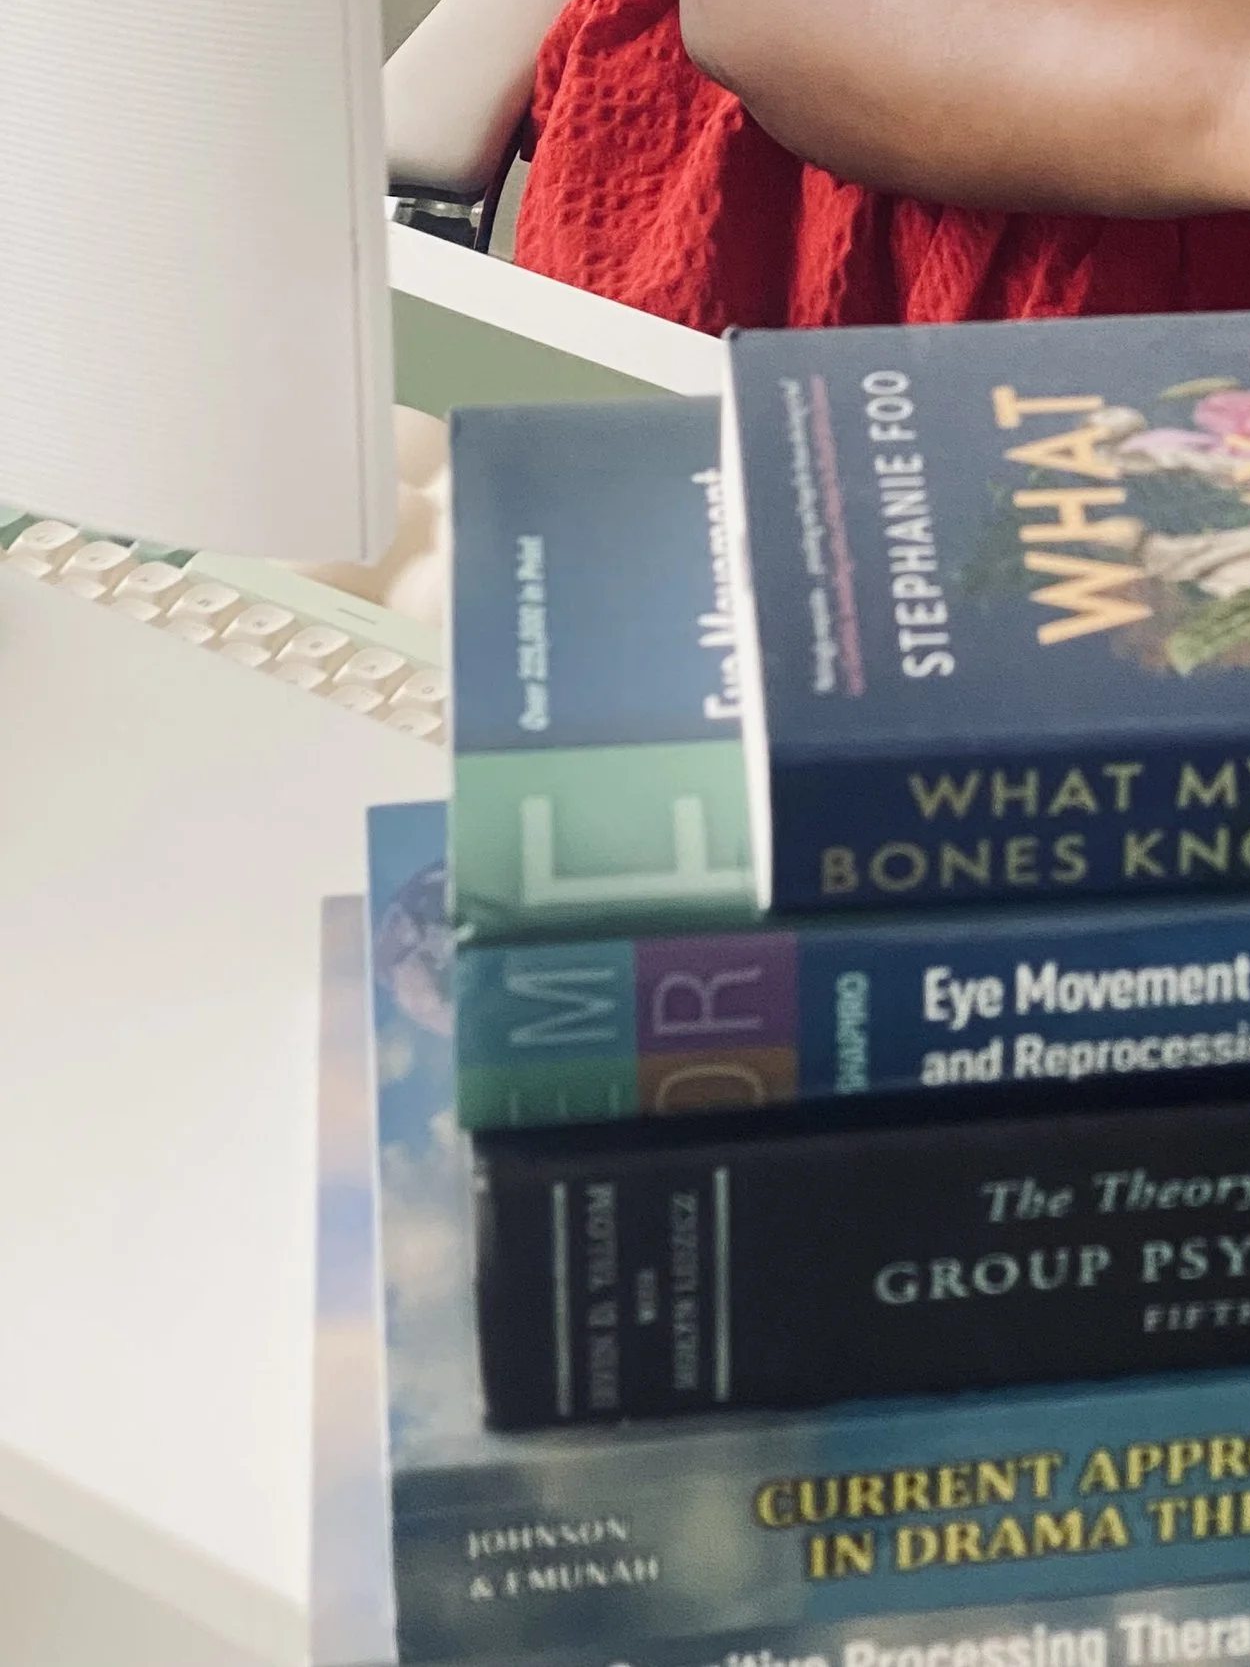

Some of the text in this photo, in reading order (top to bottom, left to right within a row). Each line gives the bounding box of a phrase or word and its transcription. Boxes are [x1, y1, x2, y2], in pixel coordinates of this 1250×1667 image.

[860, 369, 956, 679] STEPHANIE FOO
[991, 384, 1156, 647] WHAT
[908, 762, 1144, 821] WHAT
[820, 832, 1089, 895] BONES
[922, 965, 1004, 1031] Eye
[920, 1036, 1003, 1088] and
[980, 1176, 1076, 1224] The
[873, 1243, 1113, 1306] GROUP
[755, 1449, 1063, 1531] CURRENT
[467, 1516, 630, 1561] JOHNSON
[807, 1531, 876, 1581] IN
[895, 1503, 1131, 1573] DRAMA
[468, 1554, 662, 1602] & EMUNAH
